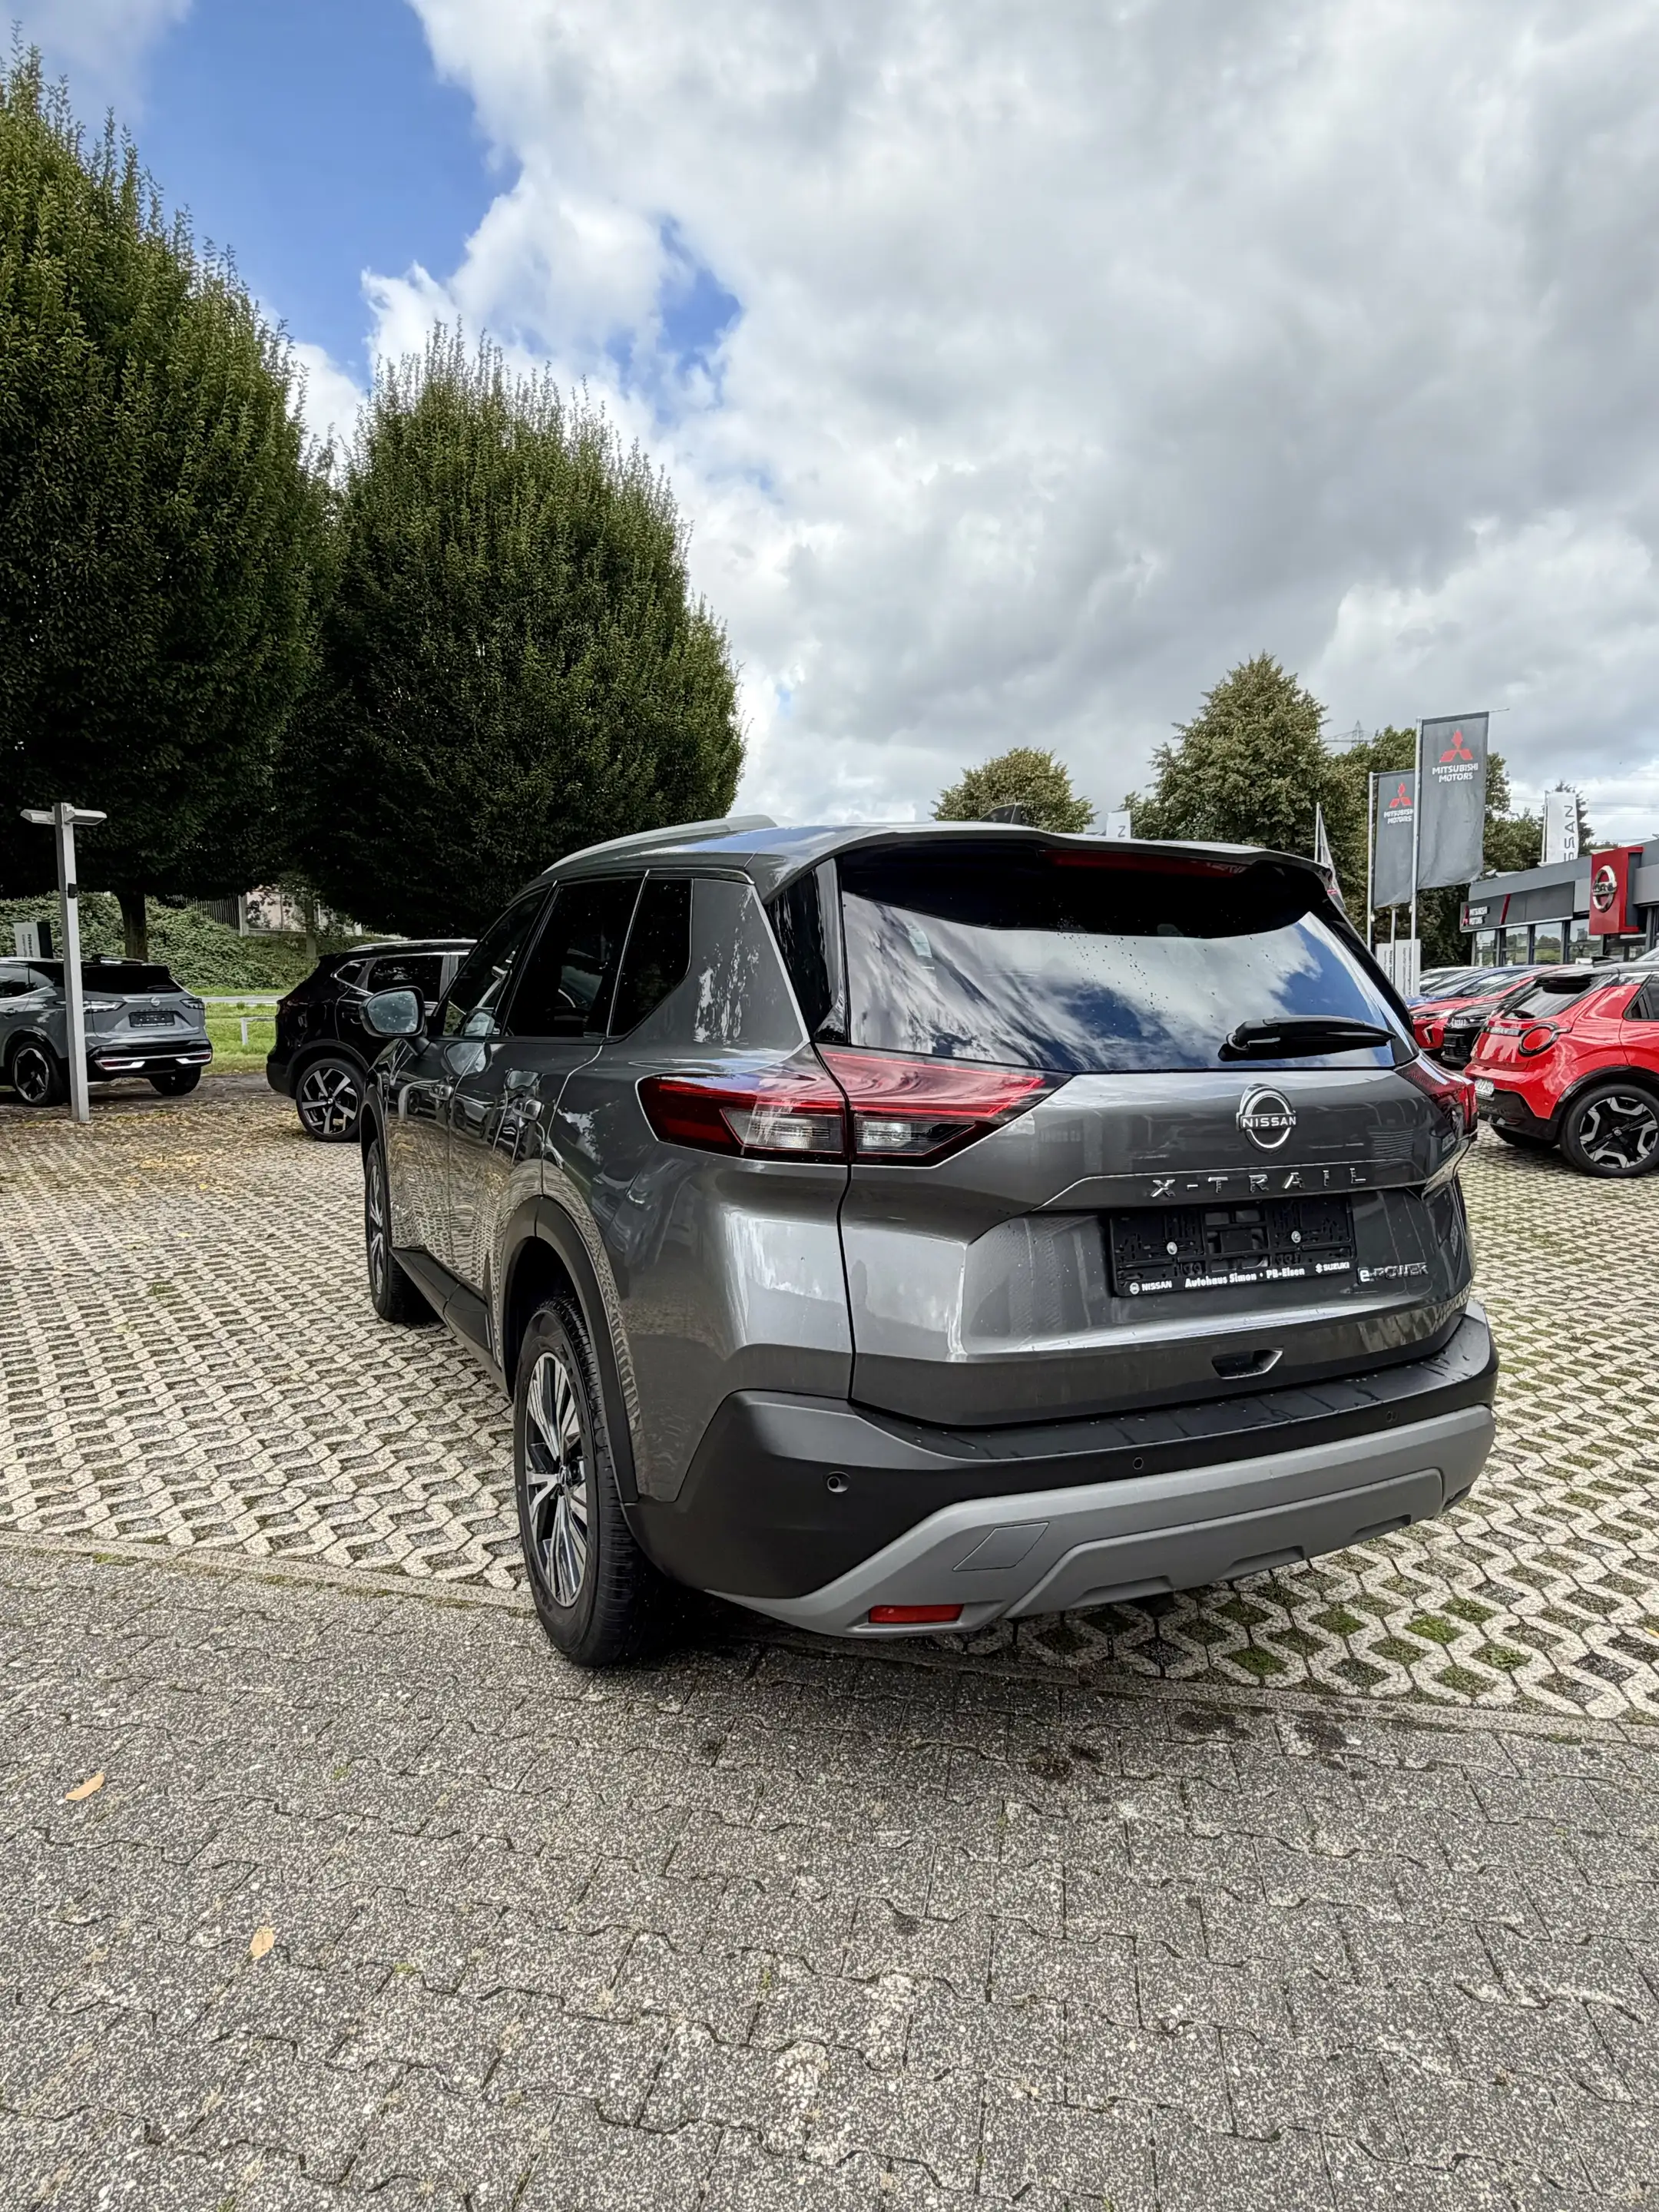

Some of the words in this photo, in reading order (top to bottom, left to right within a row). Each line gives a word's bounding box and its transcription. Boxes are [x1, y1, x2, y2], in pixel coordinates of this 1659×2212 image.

[1432, 763, 1479, 775] MITSUBISHI
[1439, 772, 1473, 783] MOTORS
[1242, 1116, 1296, 1128] NISSAN
[1151, 1167, 1366, 1197] X-TRAIL
[1323, 1261, 1350, 1272] SUZUKI
[1141, 1280, 1173, 1292] NISSAN
[1184, 1276, 1228, 1288] Autohaus
[1229, 1273, 1257, 1283] Simon
